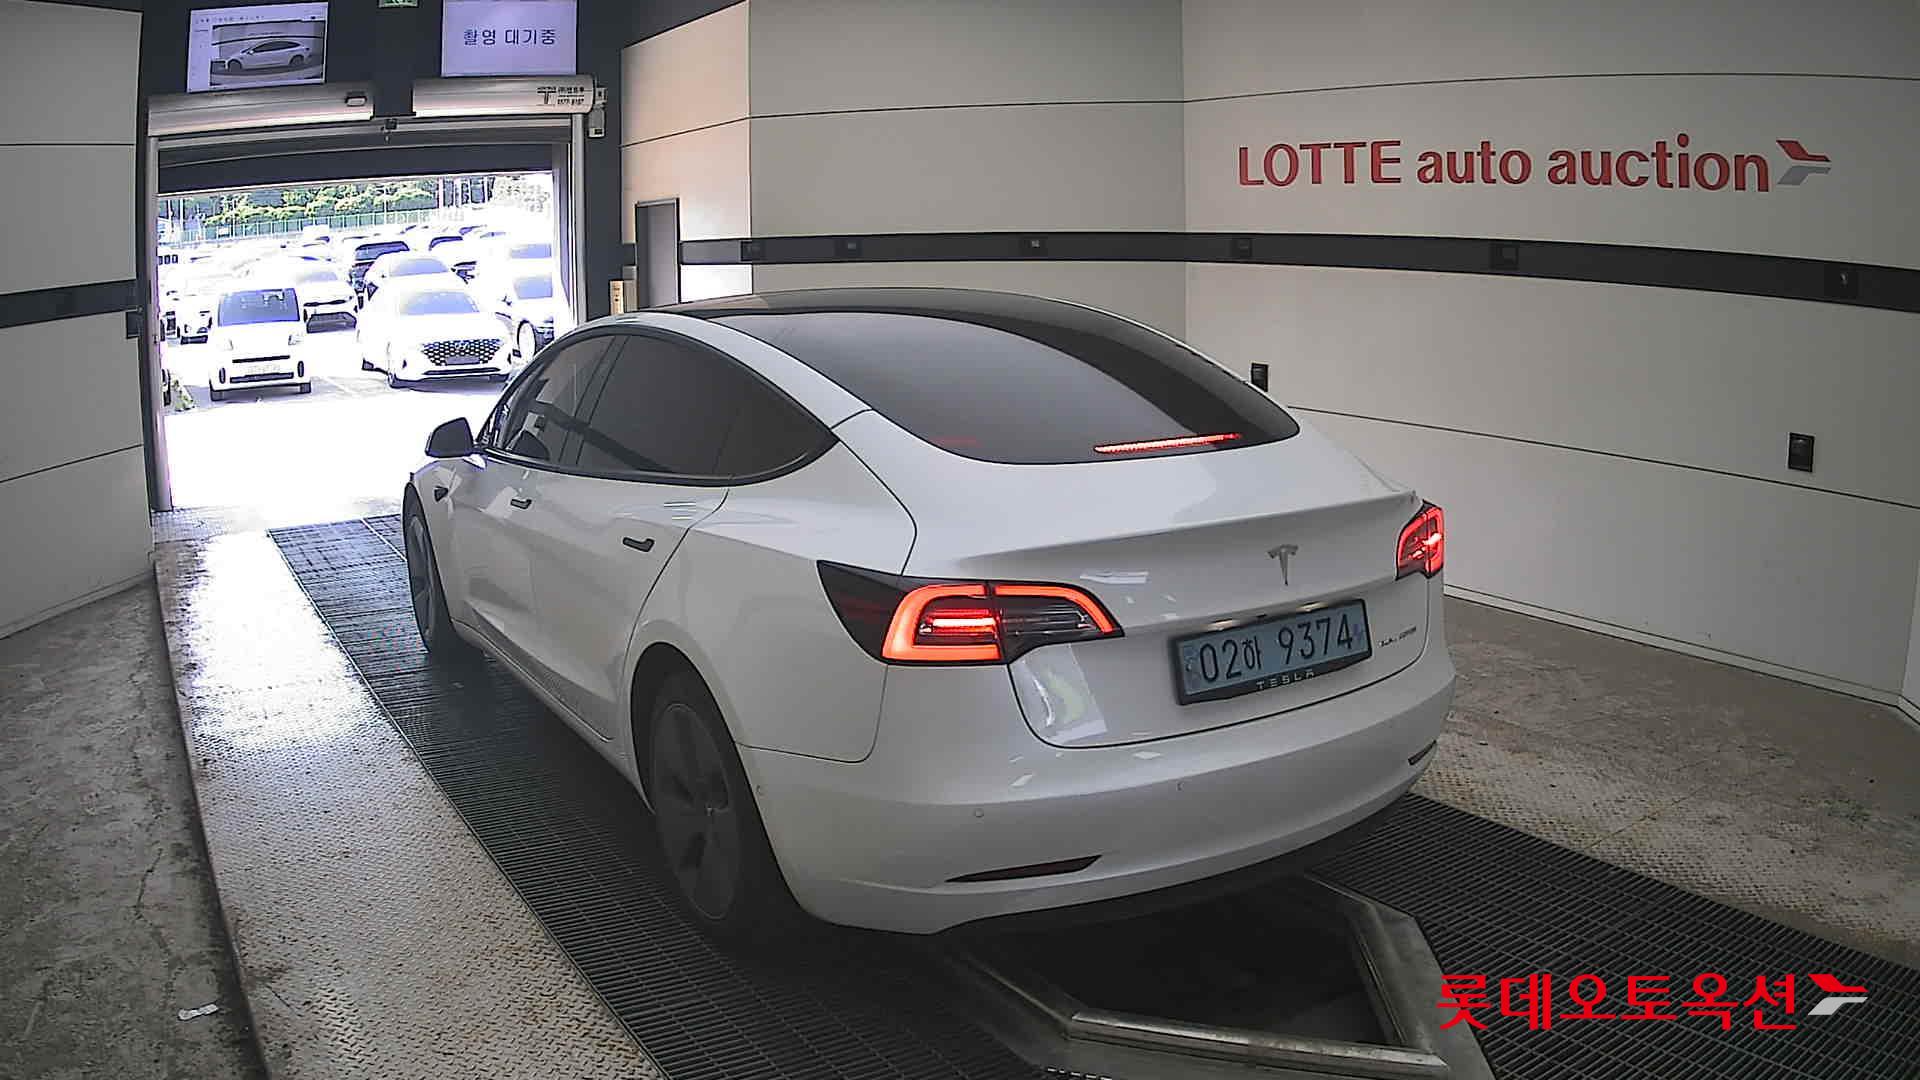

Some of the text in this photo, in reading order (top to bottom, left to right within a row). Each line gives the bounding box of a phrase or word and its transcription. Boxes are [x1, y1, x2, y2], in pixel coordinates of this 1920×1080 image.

[463, 28, 556, 46] 촬영 대기중
[1238, 133, 1770, 193] LOTTE auto auction
[1200, 635, 1262, 683] 02하
[1278, 613, 1353, 665] 9374
[1255, 669, 1315, 690] TESLA
